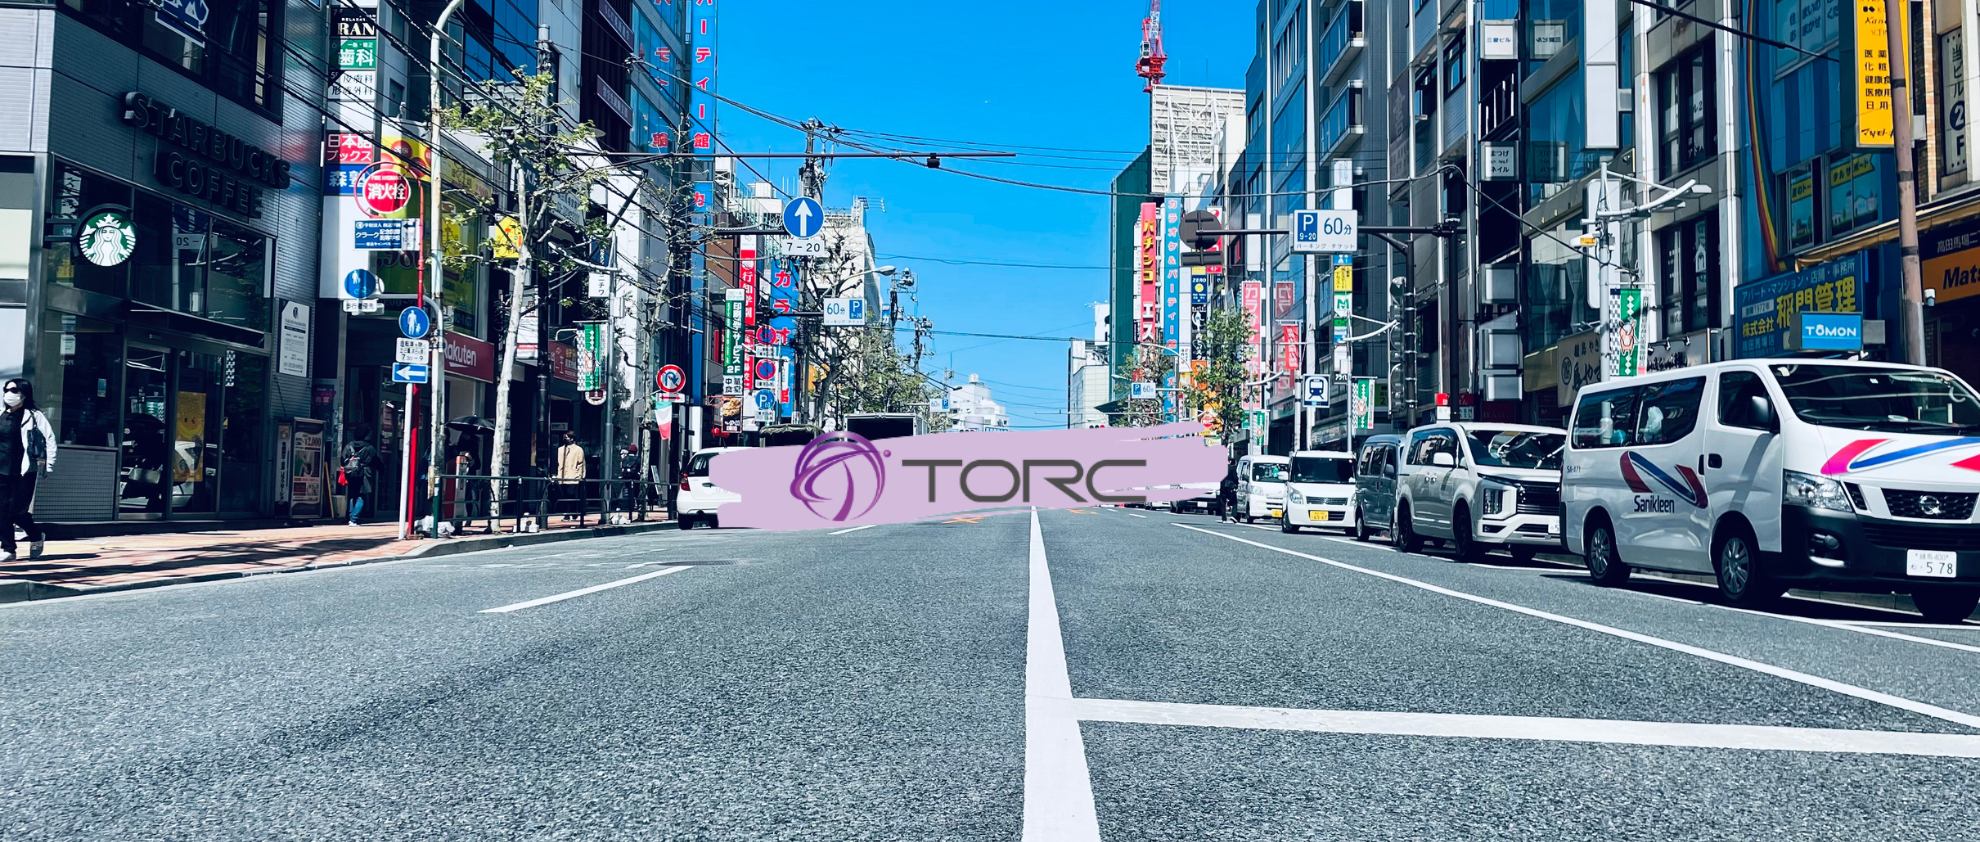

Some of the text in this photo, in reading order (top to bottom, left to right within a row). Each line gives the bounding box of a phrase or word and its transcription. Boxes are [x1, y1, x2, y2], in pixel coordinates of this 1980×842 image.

[337, 22, 375, 36] RAN
[338, 48, 374, 67] 歯科
[124, 91, 291, 190] STARBUCKS
[327, 133, 373, 149] 日本語
[327, 150, 372, 162] ブックス
[158, 151, 263, 219] COFFEE
[367, 182, 407, 200] 消火栓
[1303, 214, 1314, 231] P
[1323, 217, 1352, 236] 60分
[355, 231, 379, 239] クラーク
[1299, 232, 1317, 241] 9-20
[1937, 229, 1980, 254] 高田馬場二
[1142, 219, 1154, 284] パチンコ
[852, 304, 861, 312] P
[1743, 316, 1775, 338] 株式会社
[443, 339, 477, 367] Rakuten
[726, 366, 741, 374] 2F
[759, 395, 768, 408] P
[1633, 495, 1675, 513] Sanikleen
